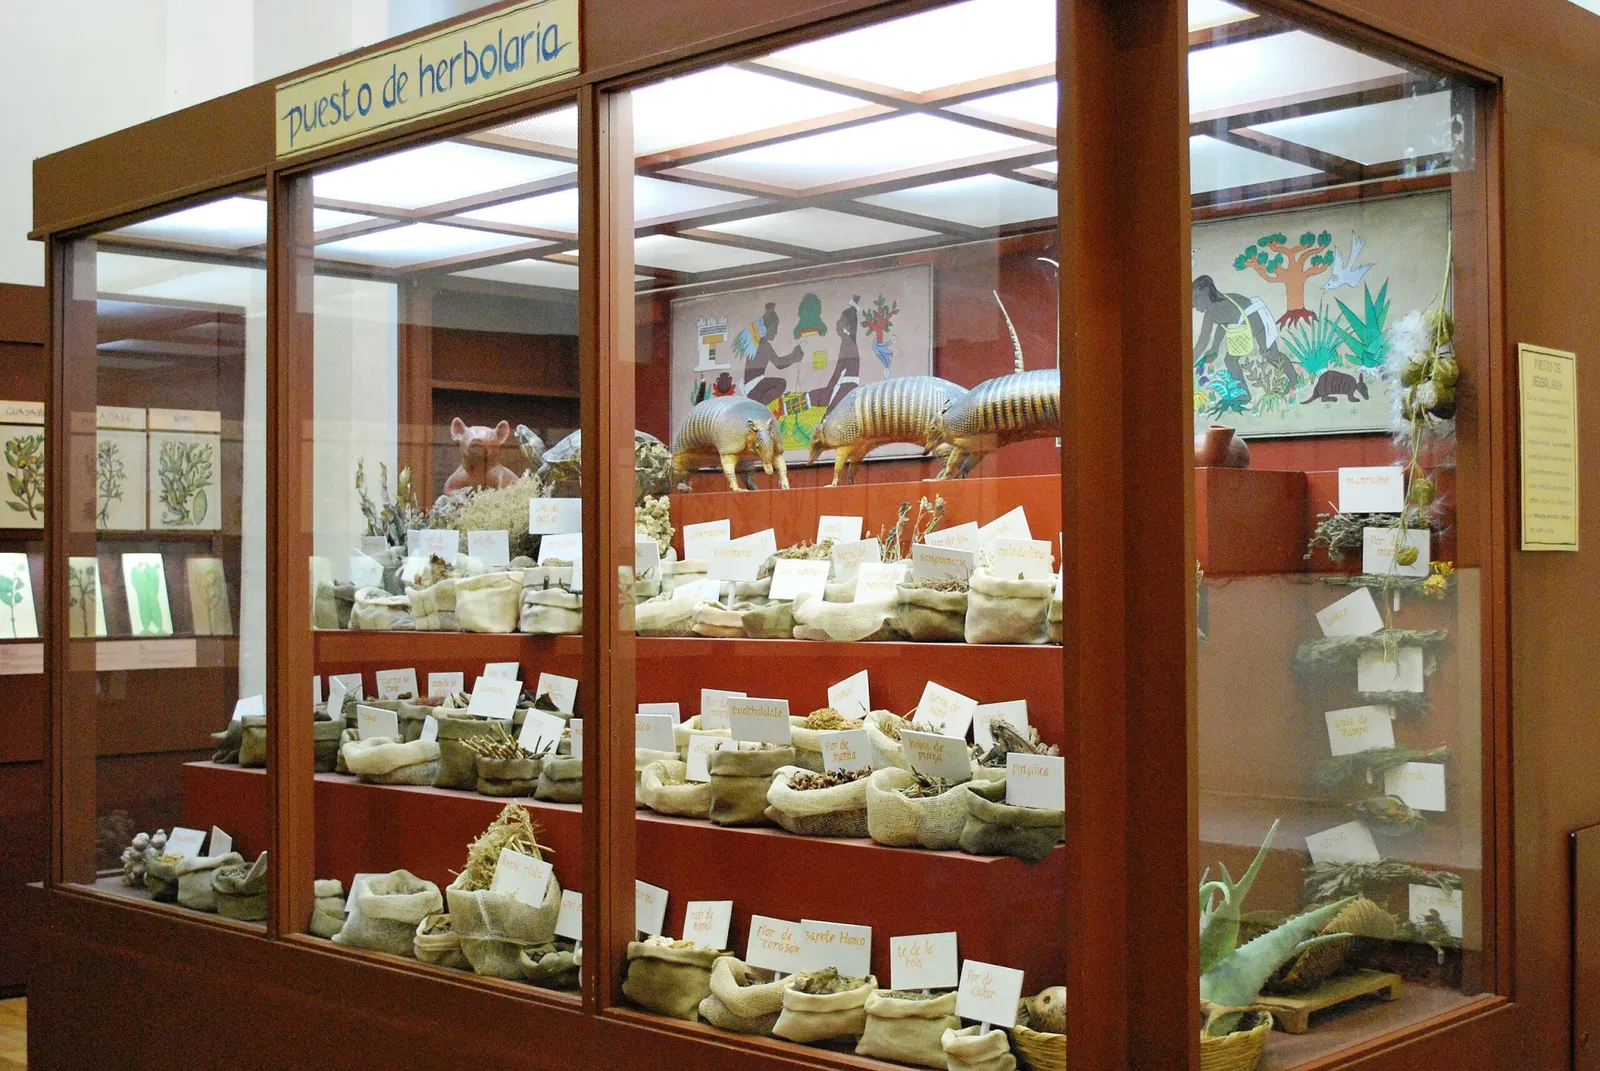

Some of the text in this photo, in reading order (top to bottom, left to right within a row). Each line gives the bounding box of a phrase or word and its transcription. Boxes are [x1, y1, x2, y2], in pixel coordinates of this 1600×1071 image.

[281, 22, 571, 148] puesto de herbolaria
[840, 739, 849, 750] de
[933, 741, 944, 753] de
[756, 923, 793, 941] flor de
[839, 931, 866, 946] blanco
[910, 942, 920, 956] de
